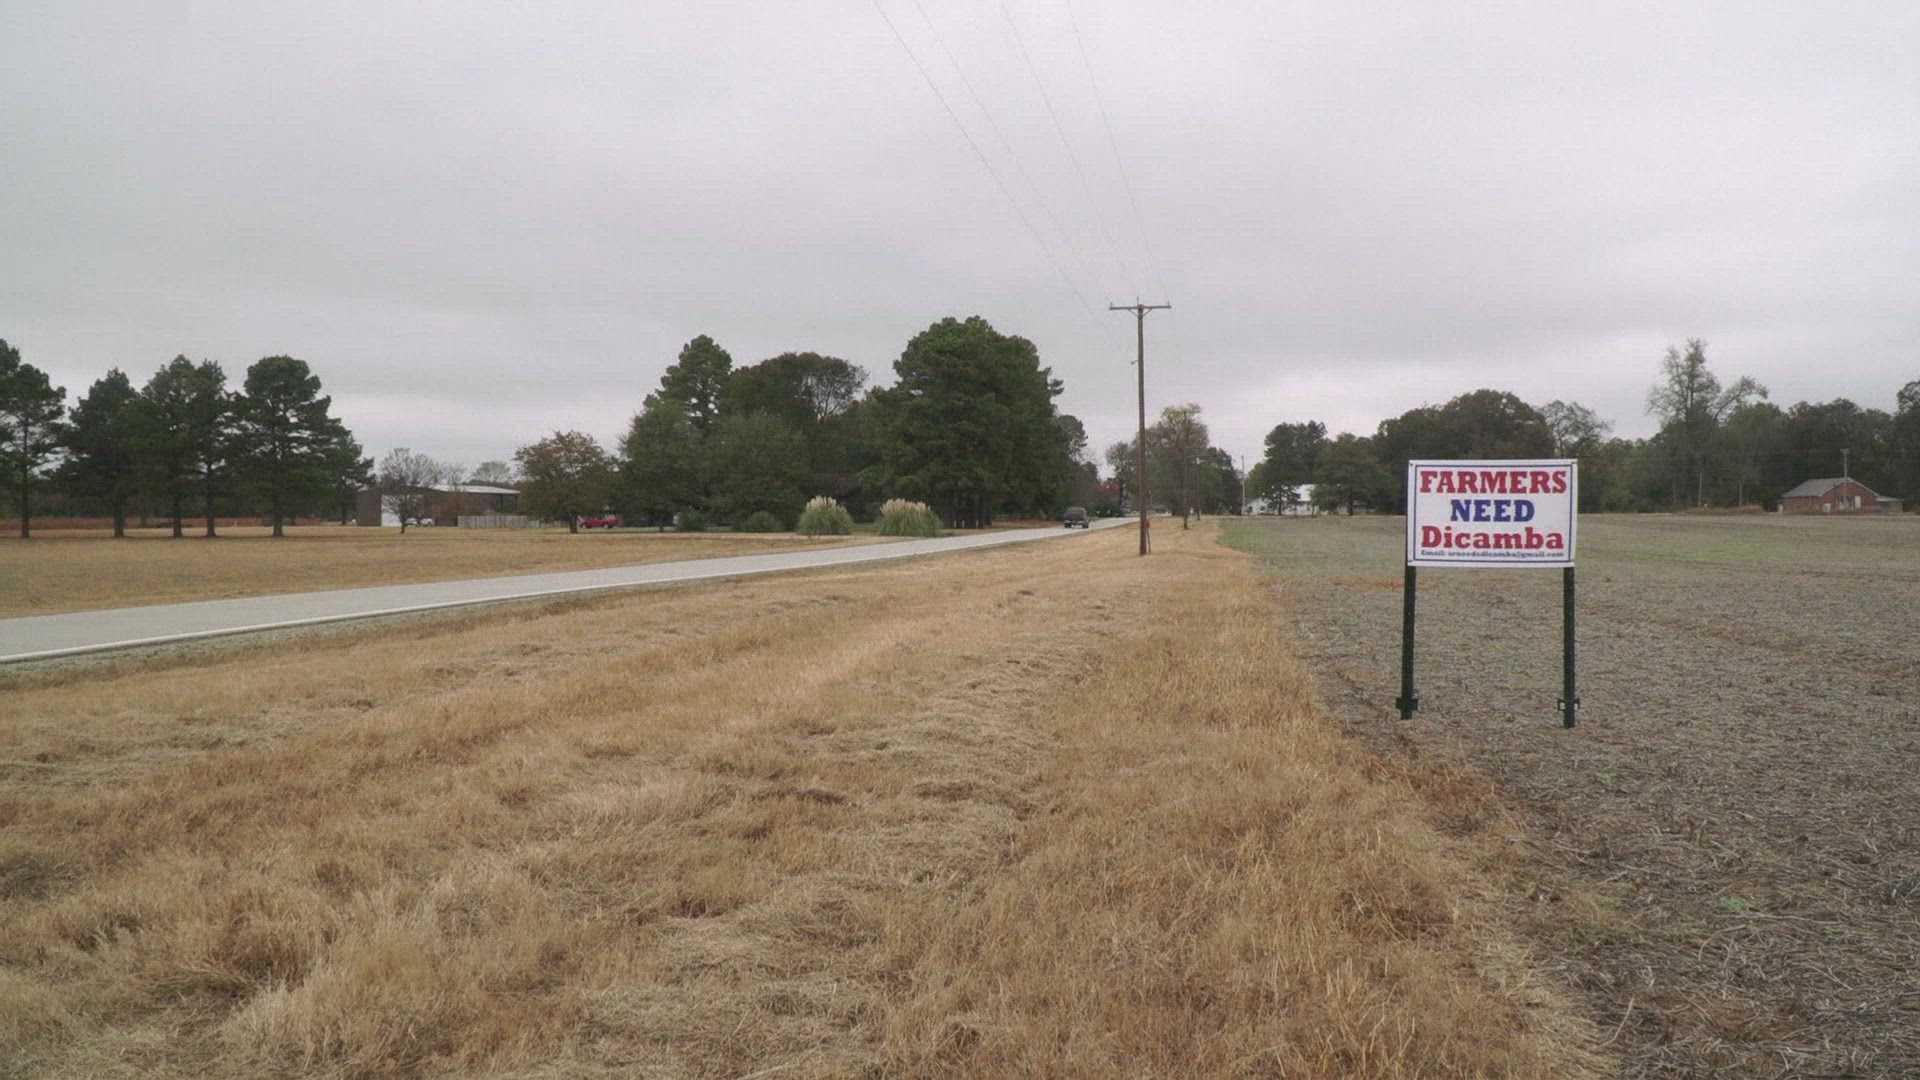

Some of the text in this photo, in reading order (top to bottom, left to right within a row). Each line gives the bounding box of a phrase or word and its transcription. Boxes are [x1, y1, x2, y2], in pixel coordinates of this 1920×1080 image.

[1420, 470, 1567, 494] FARMERS
[1450, 499, 1535, 522] NEED
[1421, 525, 1564, 549] Dicamba
